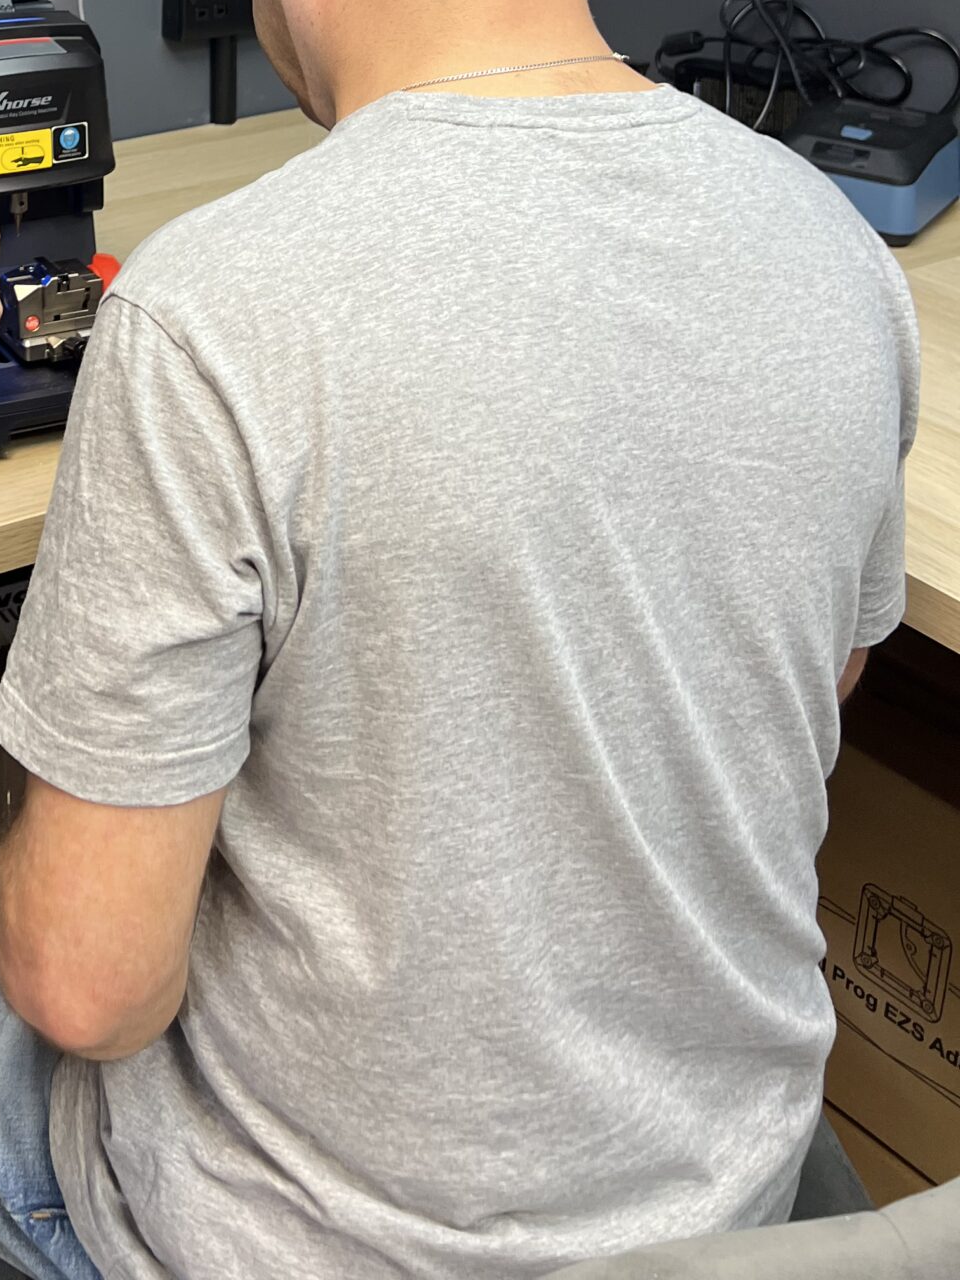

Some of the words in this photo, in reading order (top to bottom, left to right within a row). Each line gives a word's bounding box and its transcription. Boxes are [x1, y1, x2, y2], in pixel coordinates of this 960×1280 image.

[832, 964, 878, 1013] Prog
[884, 1002, 925, 1042] EZS
[929, 1037, 960, 1070] Ad
